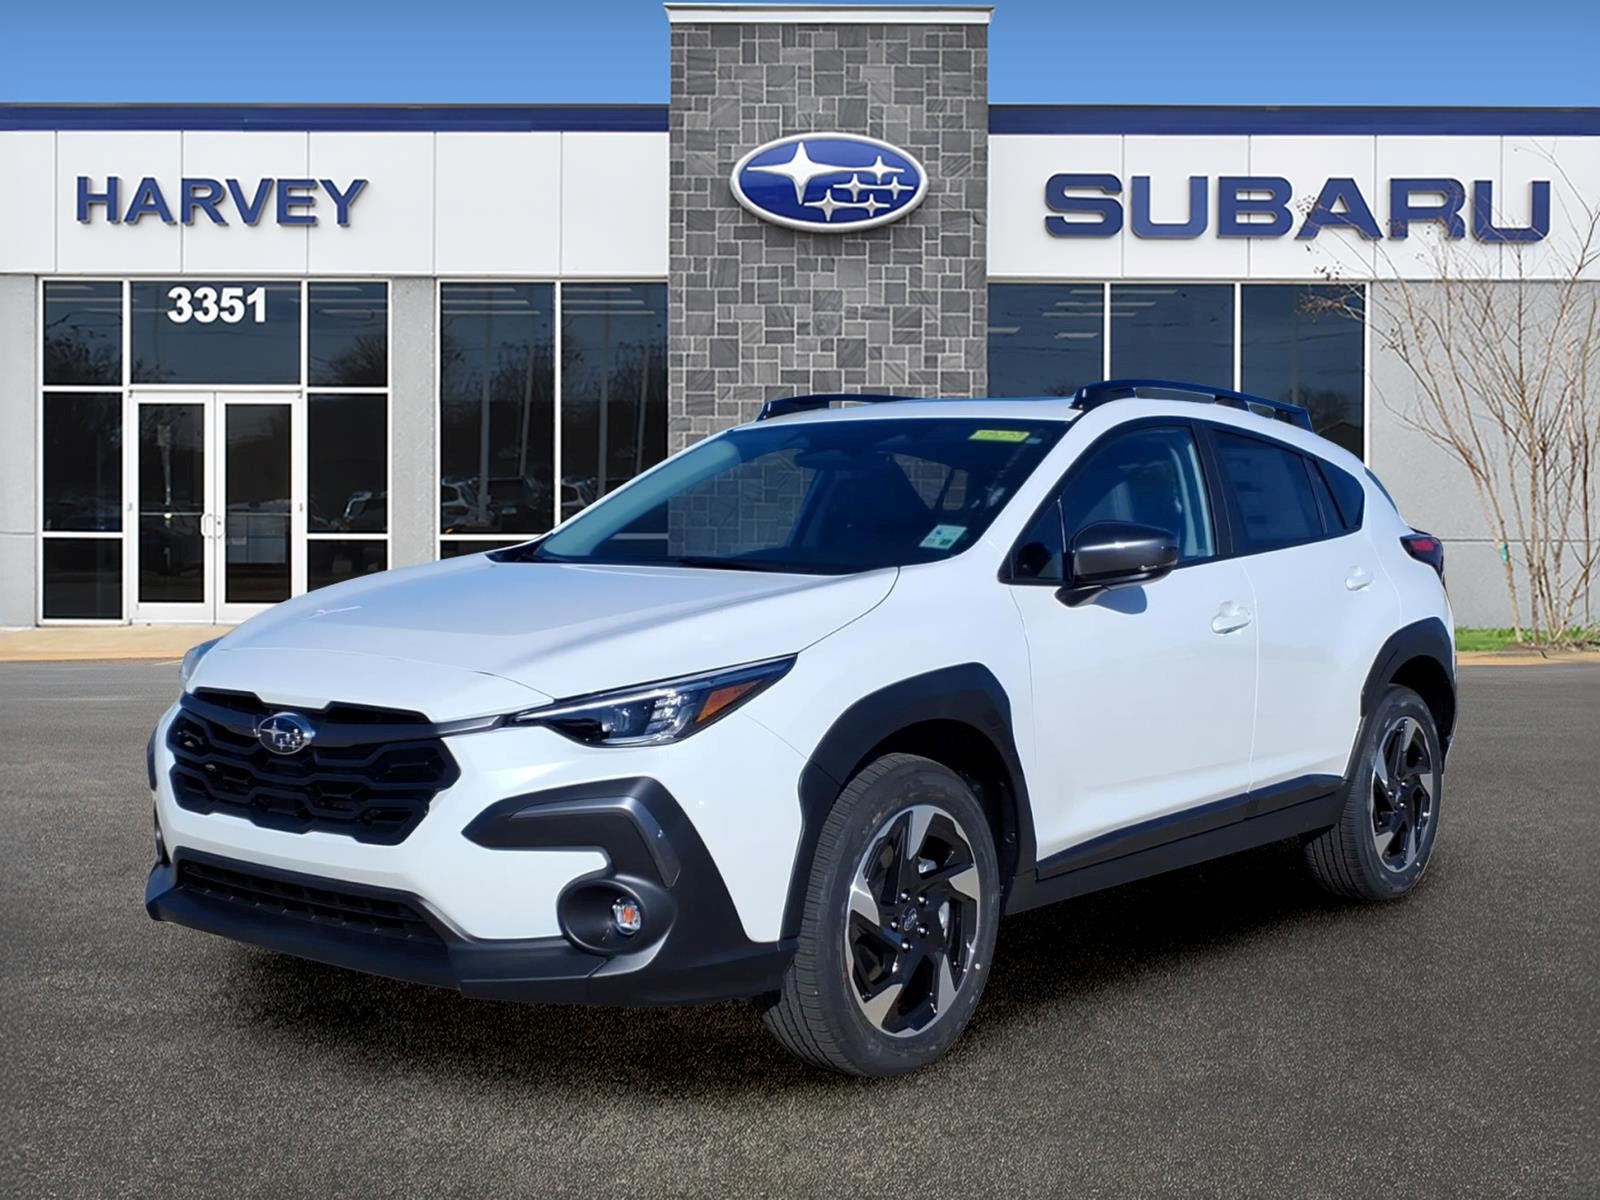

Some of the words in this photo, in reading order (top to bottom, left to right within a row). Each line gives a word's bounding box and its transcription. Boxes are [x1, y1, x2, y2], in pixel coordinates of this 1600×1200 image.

[76, 176, 368, 227] HARVEY
[1045, 173, 1551, 244] SUBARU
[166, 286, 267, 323] 3351
